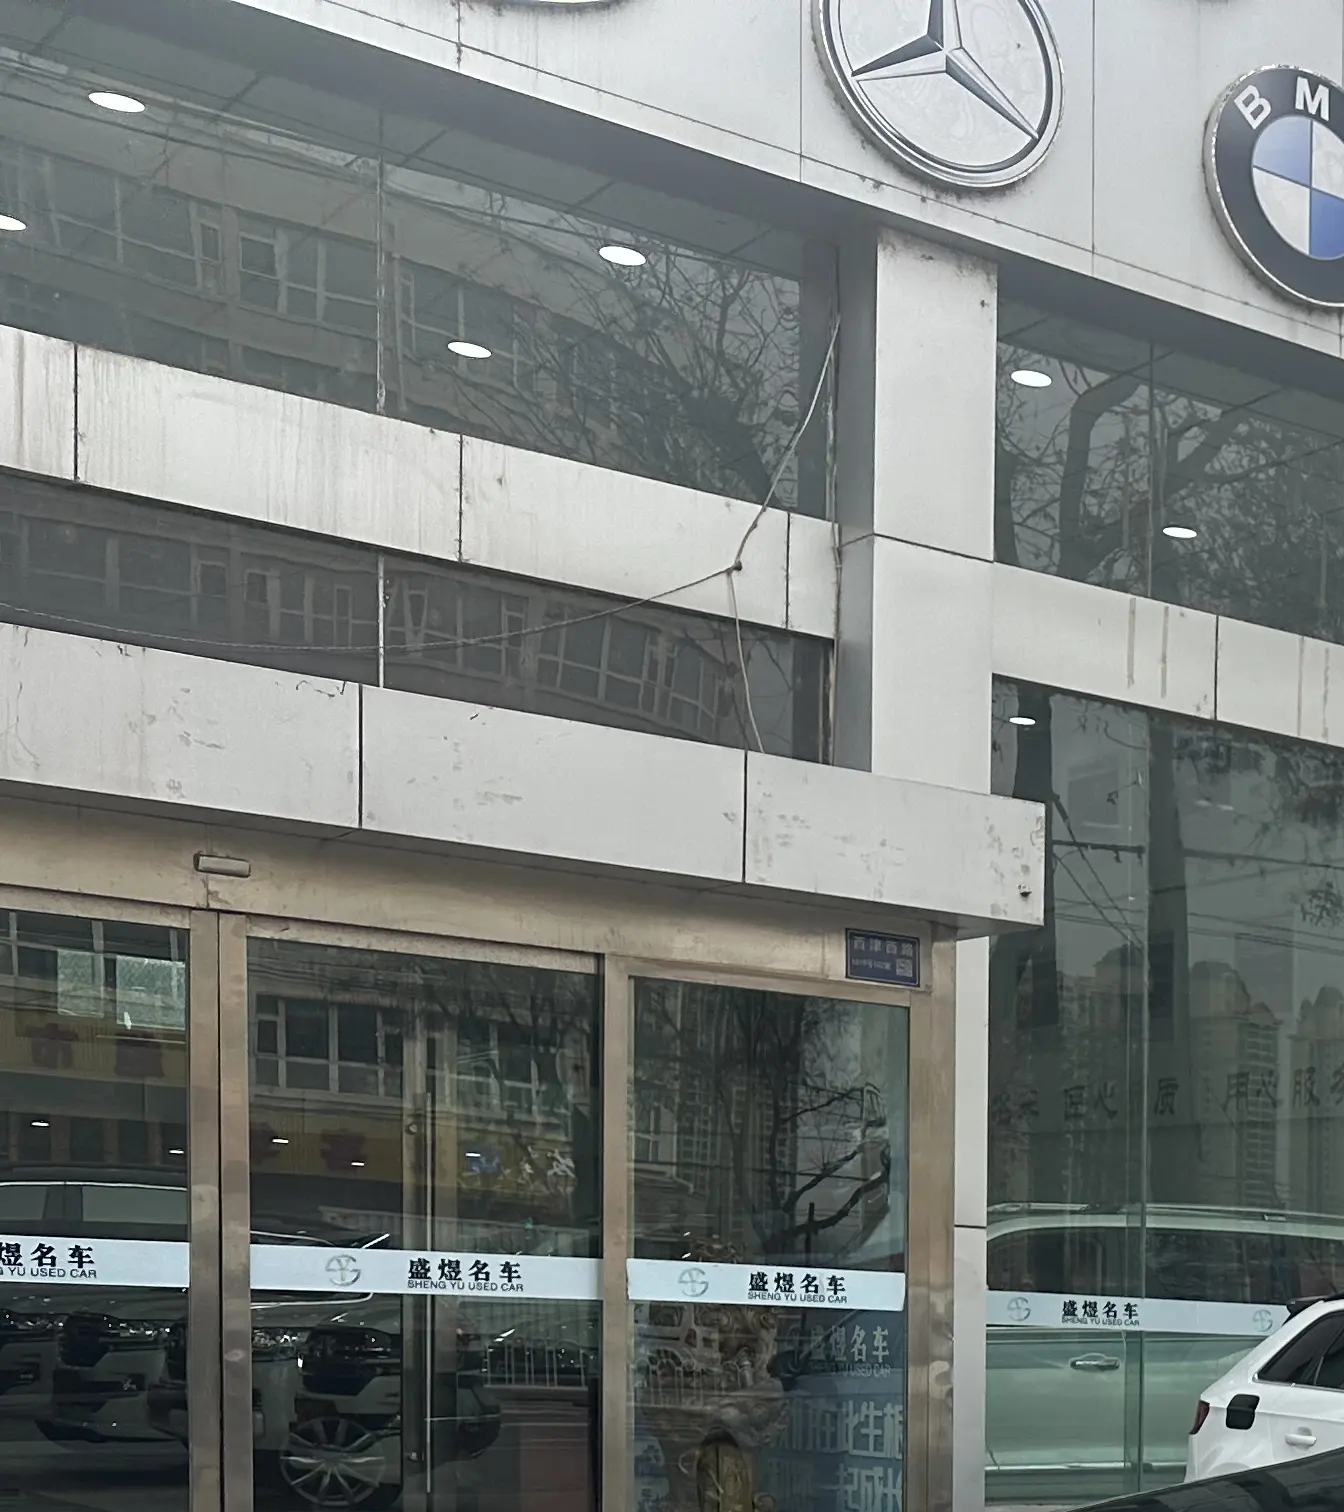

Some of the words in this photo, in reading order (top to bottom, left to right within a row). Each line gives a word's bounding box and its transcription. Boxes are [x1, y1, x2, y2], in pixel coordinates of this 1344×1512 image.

[8, 1267, 27, 1276] YU
[30, 1268, 66, 1278] USED
[69, 1269, 97, 1279] CAR
[407, 1257, 522, 1284] 盛煜名车
[407, 1279, 448, 1290] SHENG
[450, 1280, 465, 1290] YU
[468, 1281, 498, 1291] USED
[501, 1283, 524, 1292] CAR
[748, 1272, 846, 1295] 盛煜名车
[747, 1292, 781, 1301] SHENG
[784, 1293, 797, 1302] YU
[799, 1293, 826, 1303] USED
[828, 1294, 848, 1304] CAR
[1062, 1300, 1140, 1320] 盛煜名车
